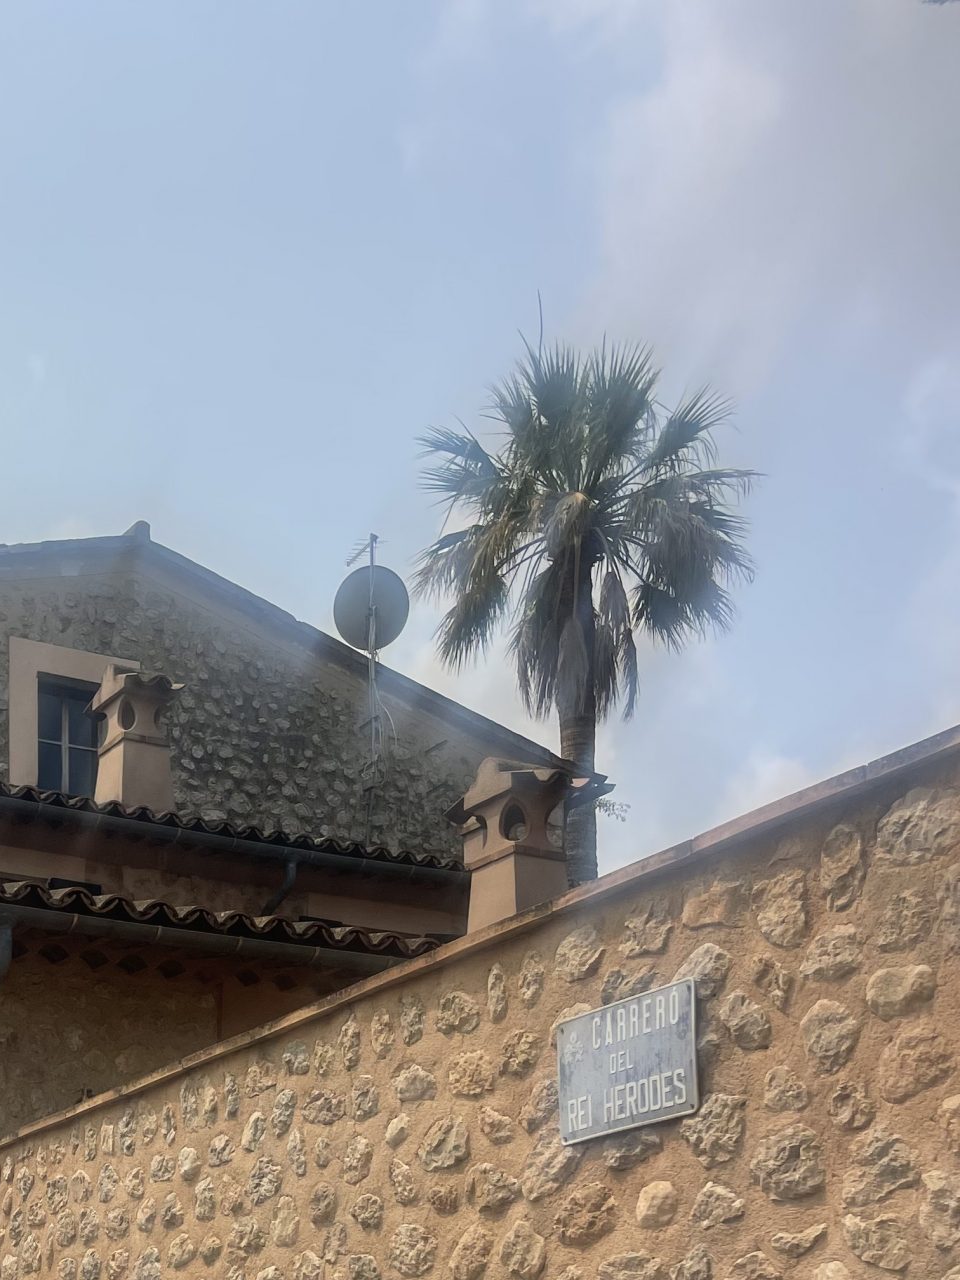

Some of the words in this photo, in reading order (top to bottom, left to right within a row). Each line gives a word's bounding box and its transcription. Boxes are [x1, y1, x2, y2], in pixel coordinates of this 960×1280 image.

[593, 987, 679, 1050] CARRERÓ
[609, 1050, 633, 1074] DEL
[568, 1095, 592, 1132] REI
[604, 1068, 686, 1123] HERODES
